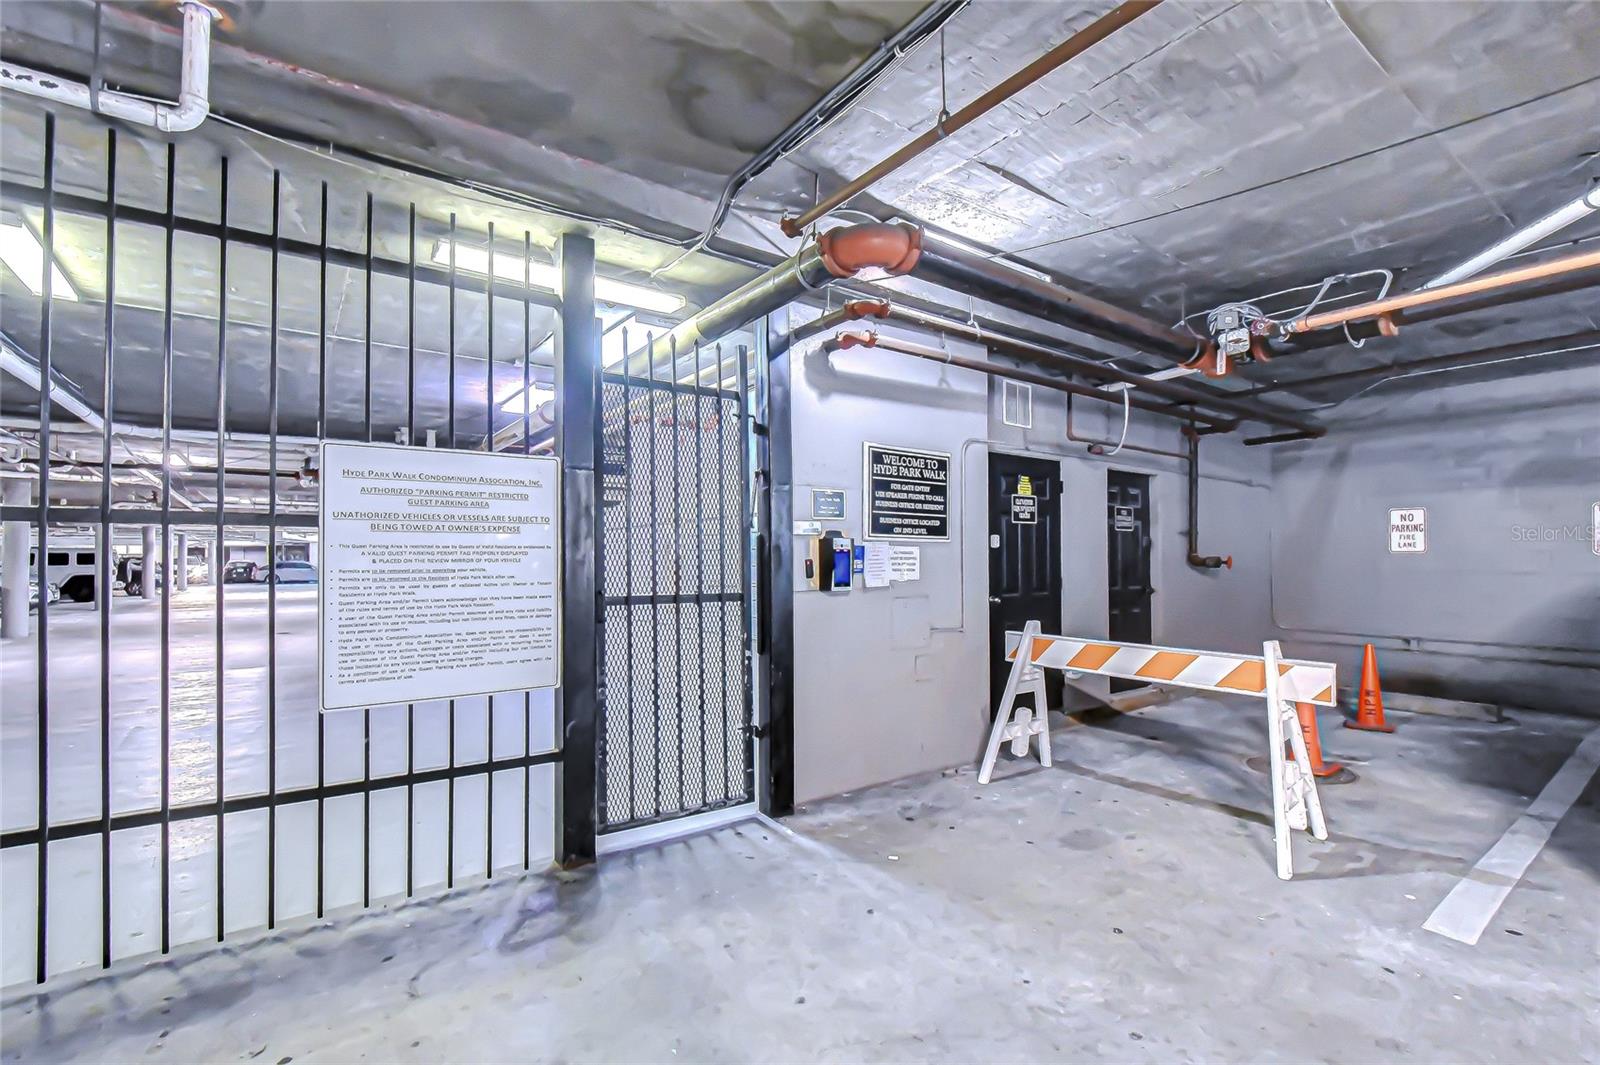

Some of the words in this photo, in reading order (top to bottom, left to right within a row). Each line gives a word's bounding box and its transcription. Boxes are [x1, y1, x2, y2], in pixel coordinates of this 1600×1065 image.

[882, 455, 925, 468] WELCOME
[926, 460, 938, 469] TO
[873, 464, 897, 475] HYDE
[900, 467, 922, 478] PARK
[923, 469, 945, 480] WALK
[360, 487, 413, 495] AUTHORIZED
[1400, 514, 1414, 522] NO
[1391, 524, 1424, 533] PARKING
